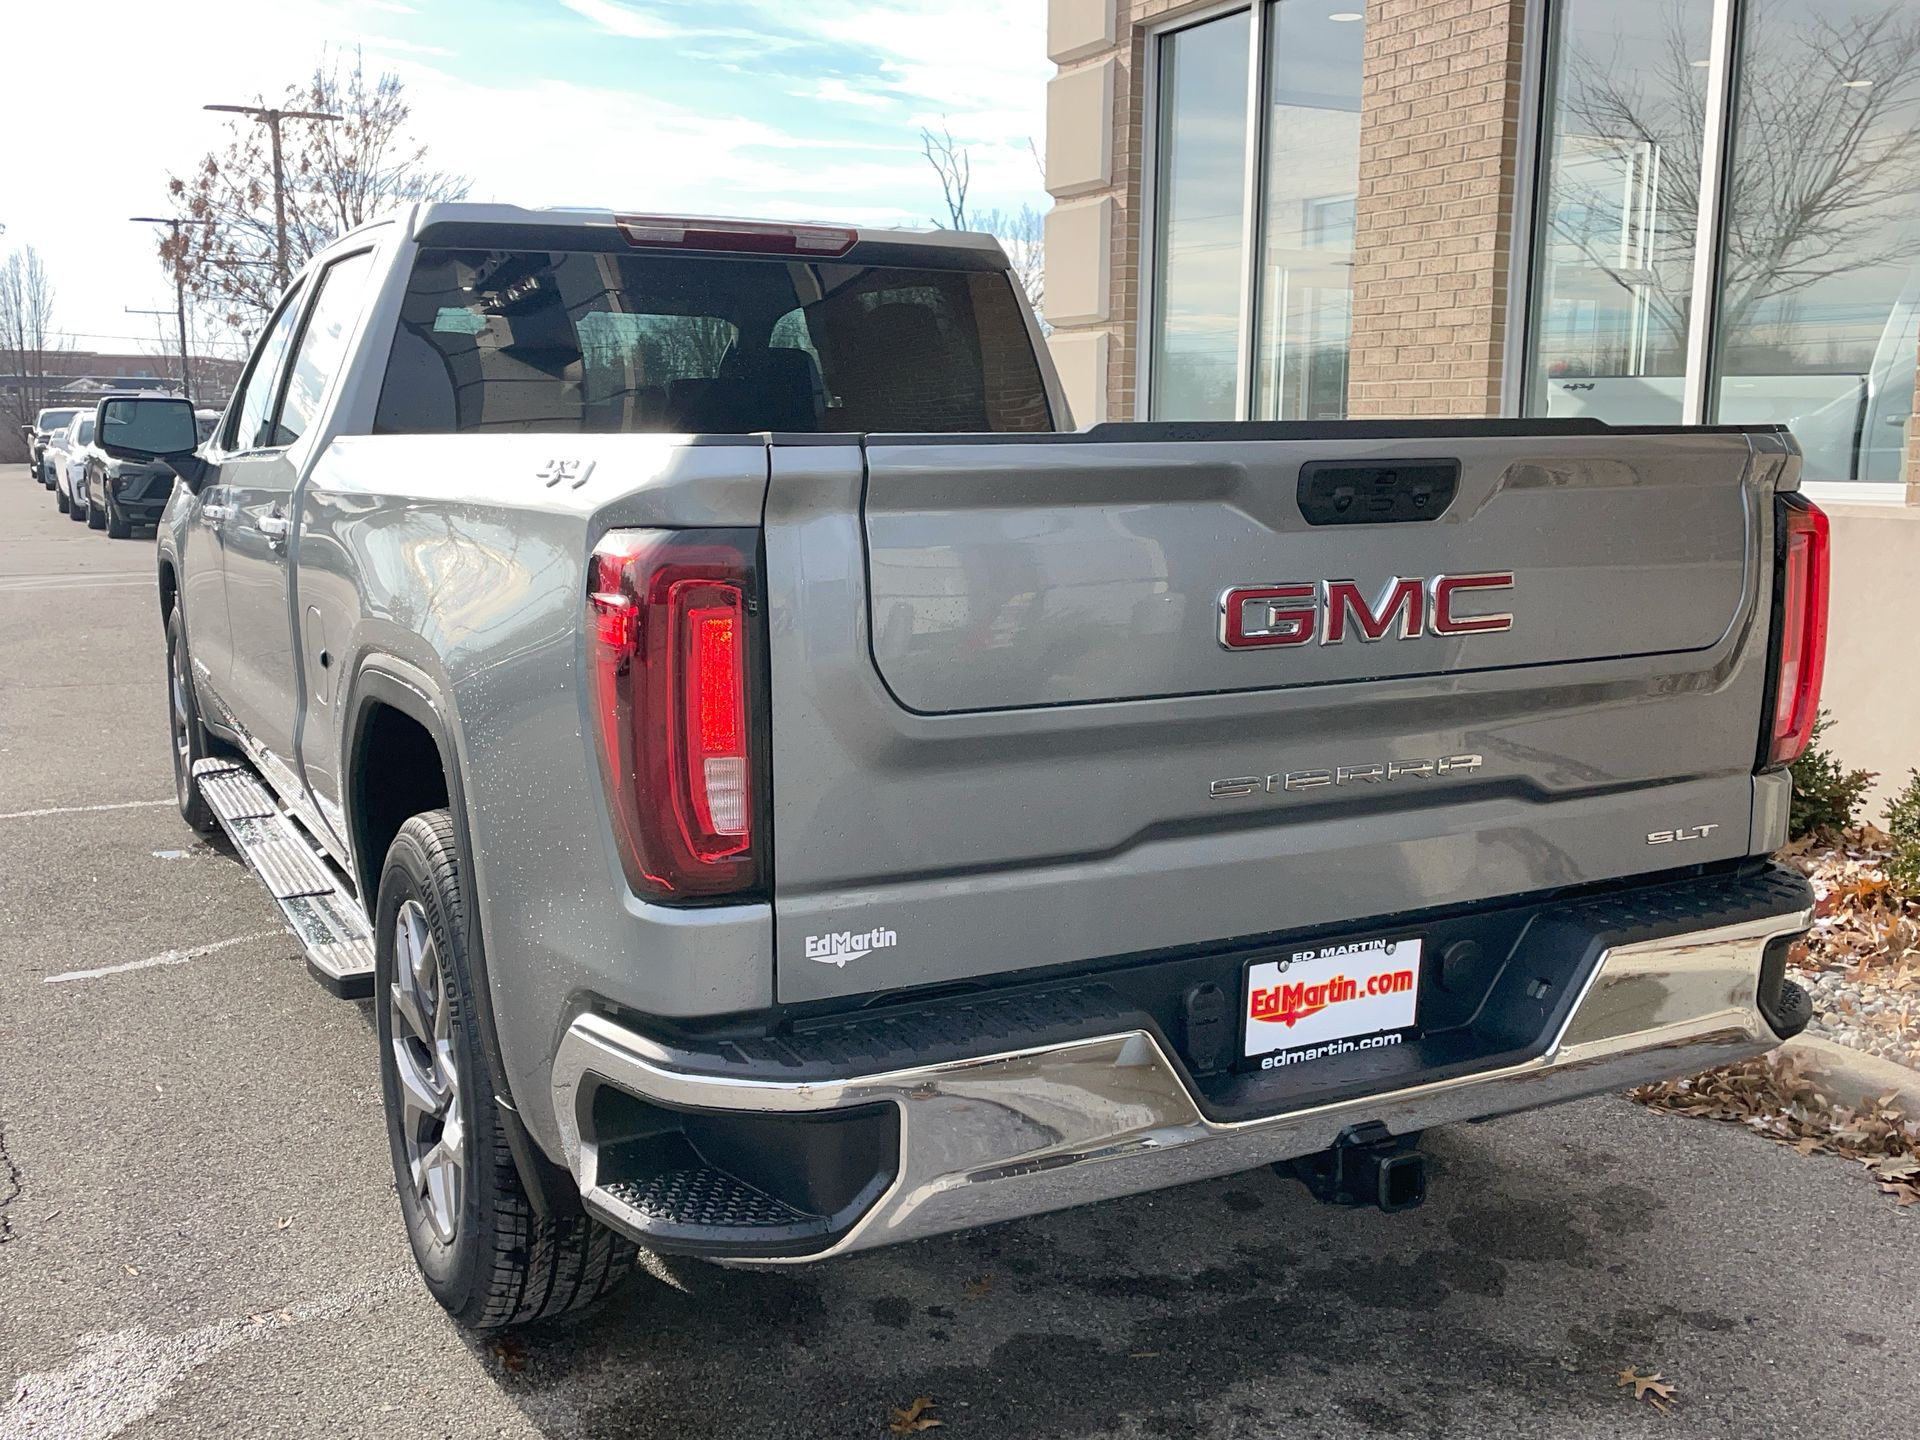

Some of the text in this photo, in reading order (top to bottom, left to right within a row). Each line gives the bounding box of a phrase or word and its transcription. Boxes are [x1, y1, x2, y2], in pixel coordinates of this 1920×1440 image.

[1217, 571, 1514, 651] GMC
[1209, 754, 1483, 799] SIERRA
[1646, 823, 1719, 845] SLT
[420, 875, 464, 1034] BRIDGESTONE
[805, 926, 897, 959] EdMartin
[1291, 939, 1387, 963] ED MARTIN
[1250, 970, 1414, 1019] EdMartin.com
[1261, 1033, 1402, 1070] edmartin.com
